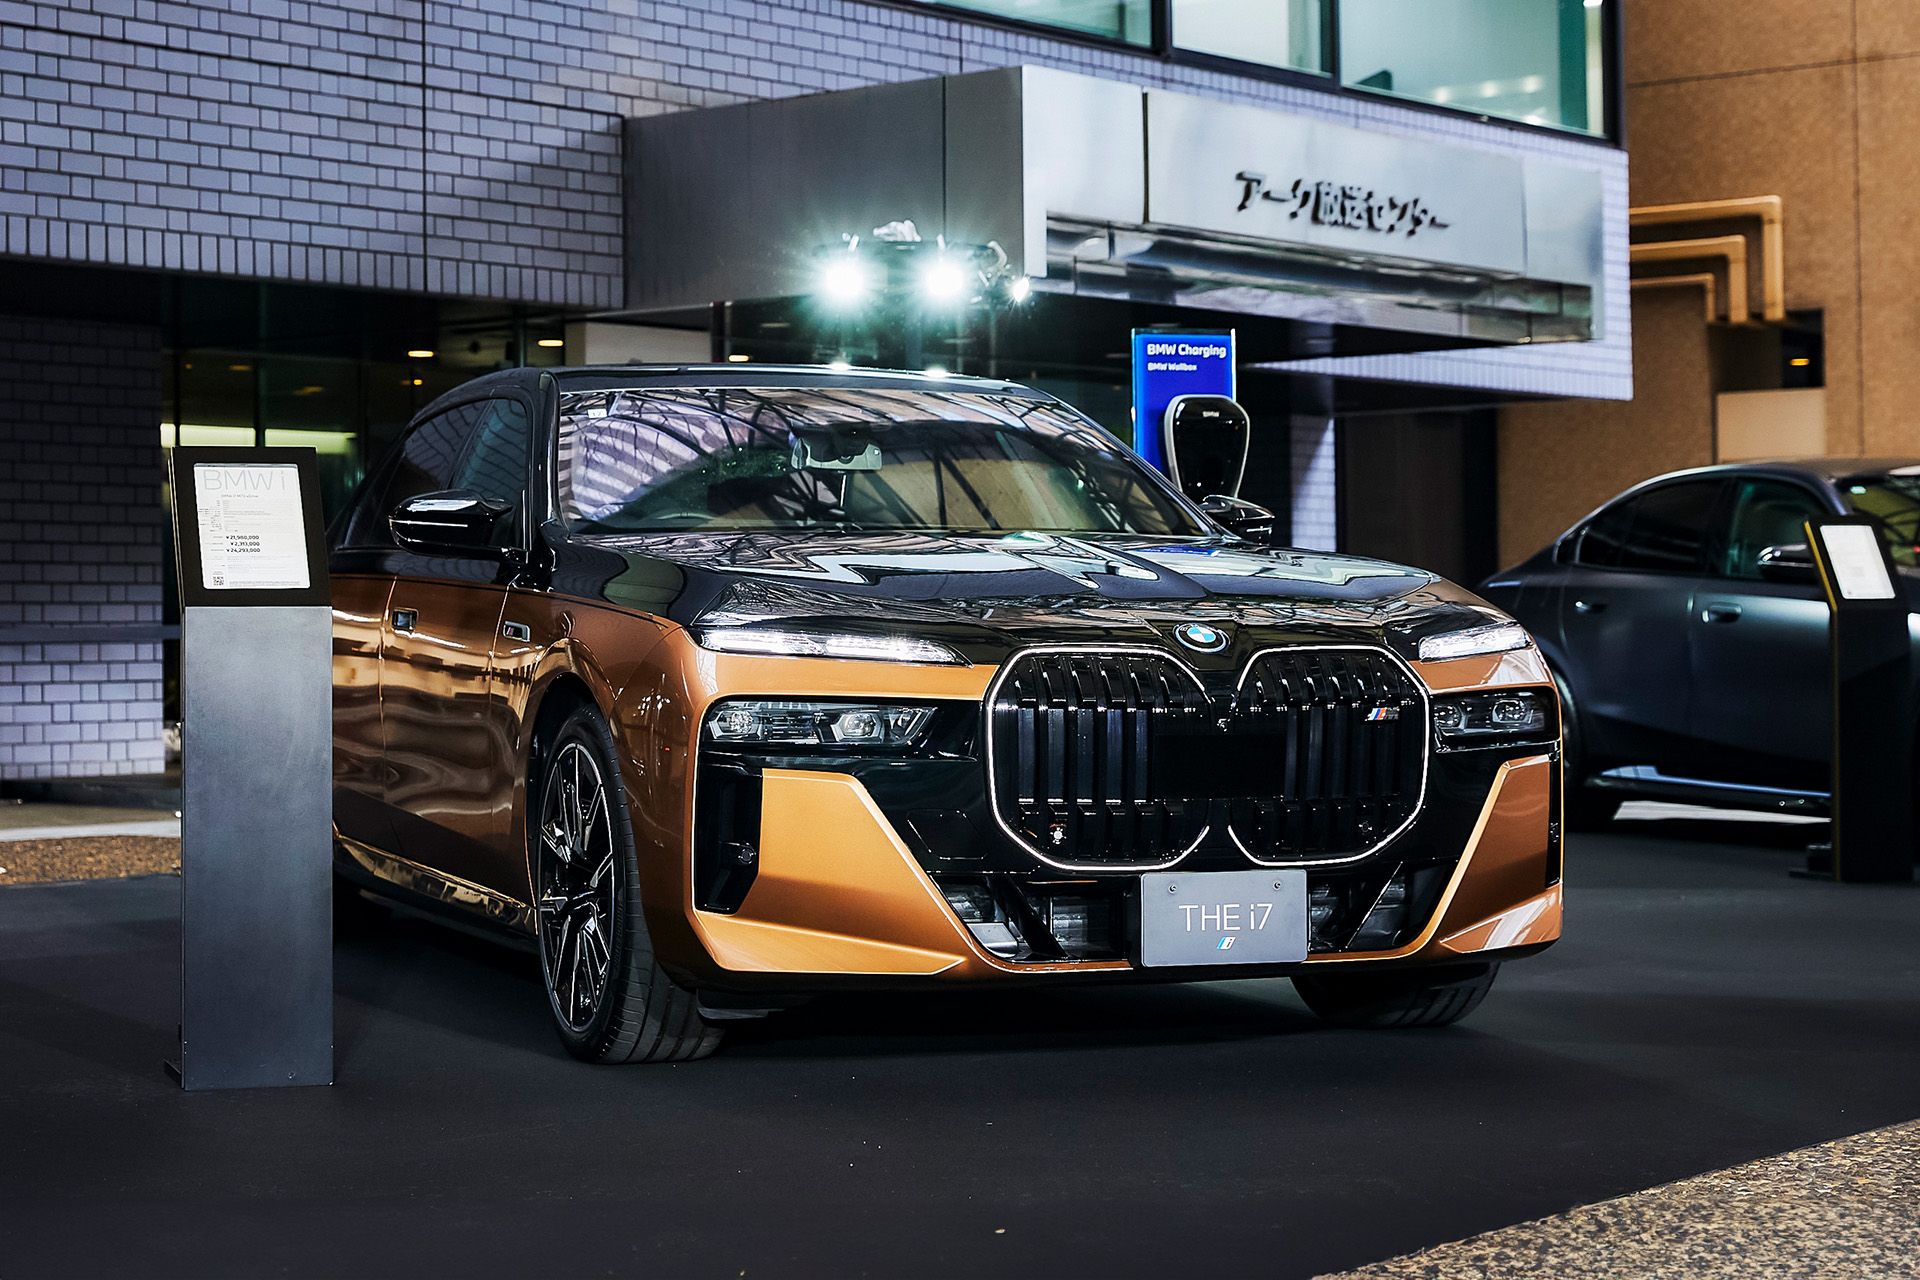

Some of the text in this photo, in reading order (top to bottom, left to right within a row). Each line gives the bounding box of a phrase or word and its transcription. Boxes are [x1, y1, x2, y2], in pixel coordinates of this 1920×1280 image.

[1147, 344, 1226, 358] BMW Charging
[1147, 362, 1167, 371] BMW
[203, 469, 273, 491] BMW
[1178, 903, 1273, 932] THE i7
